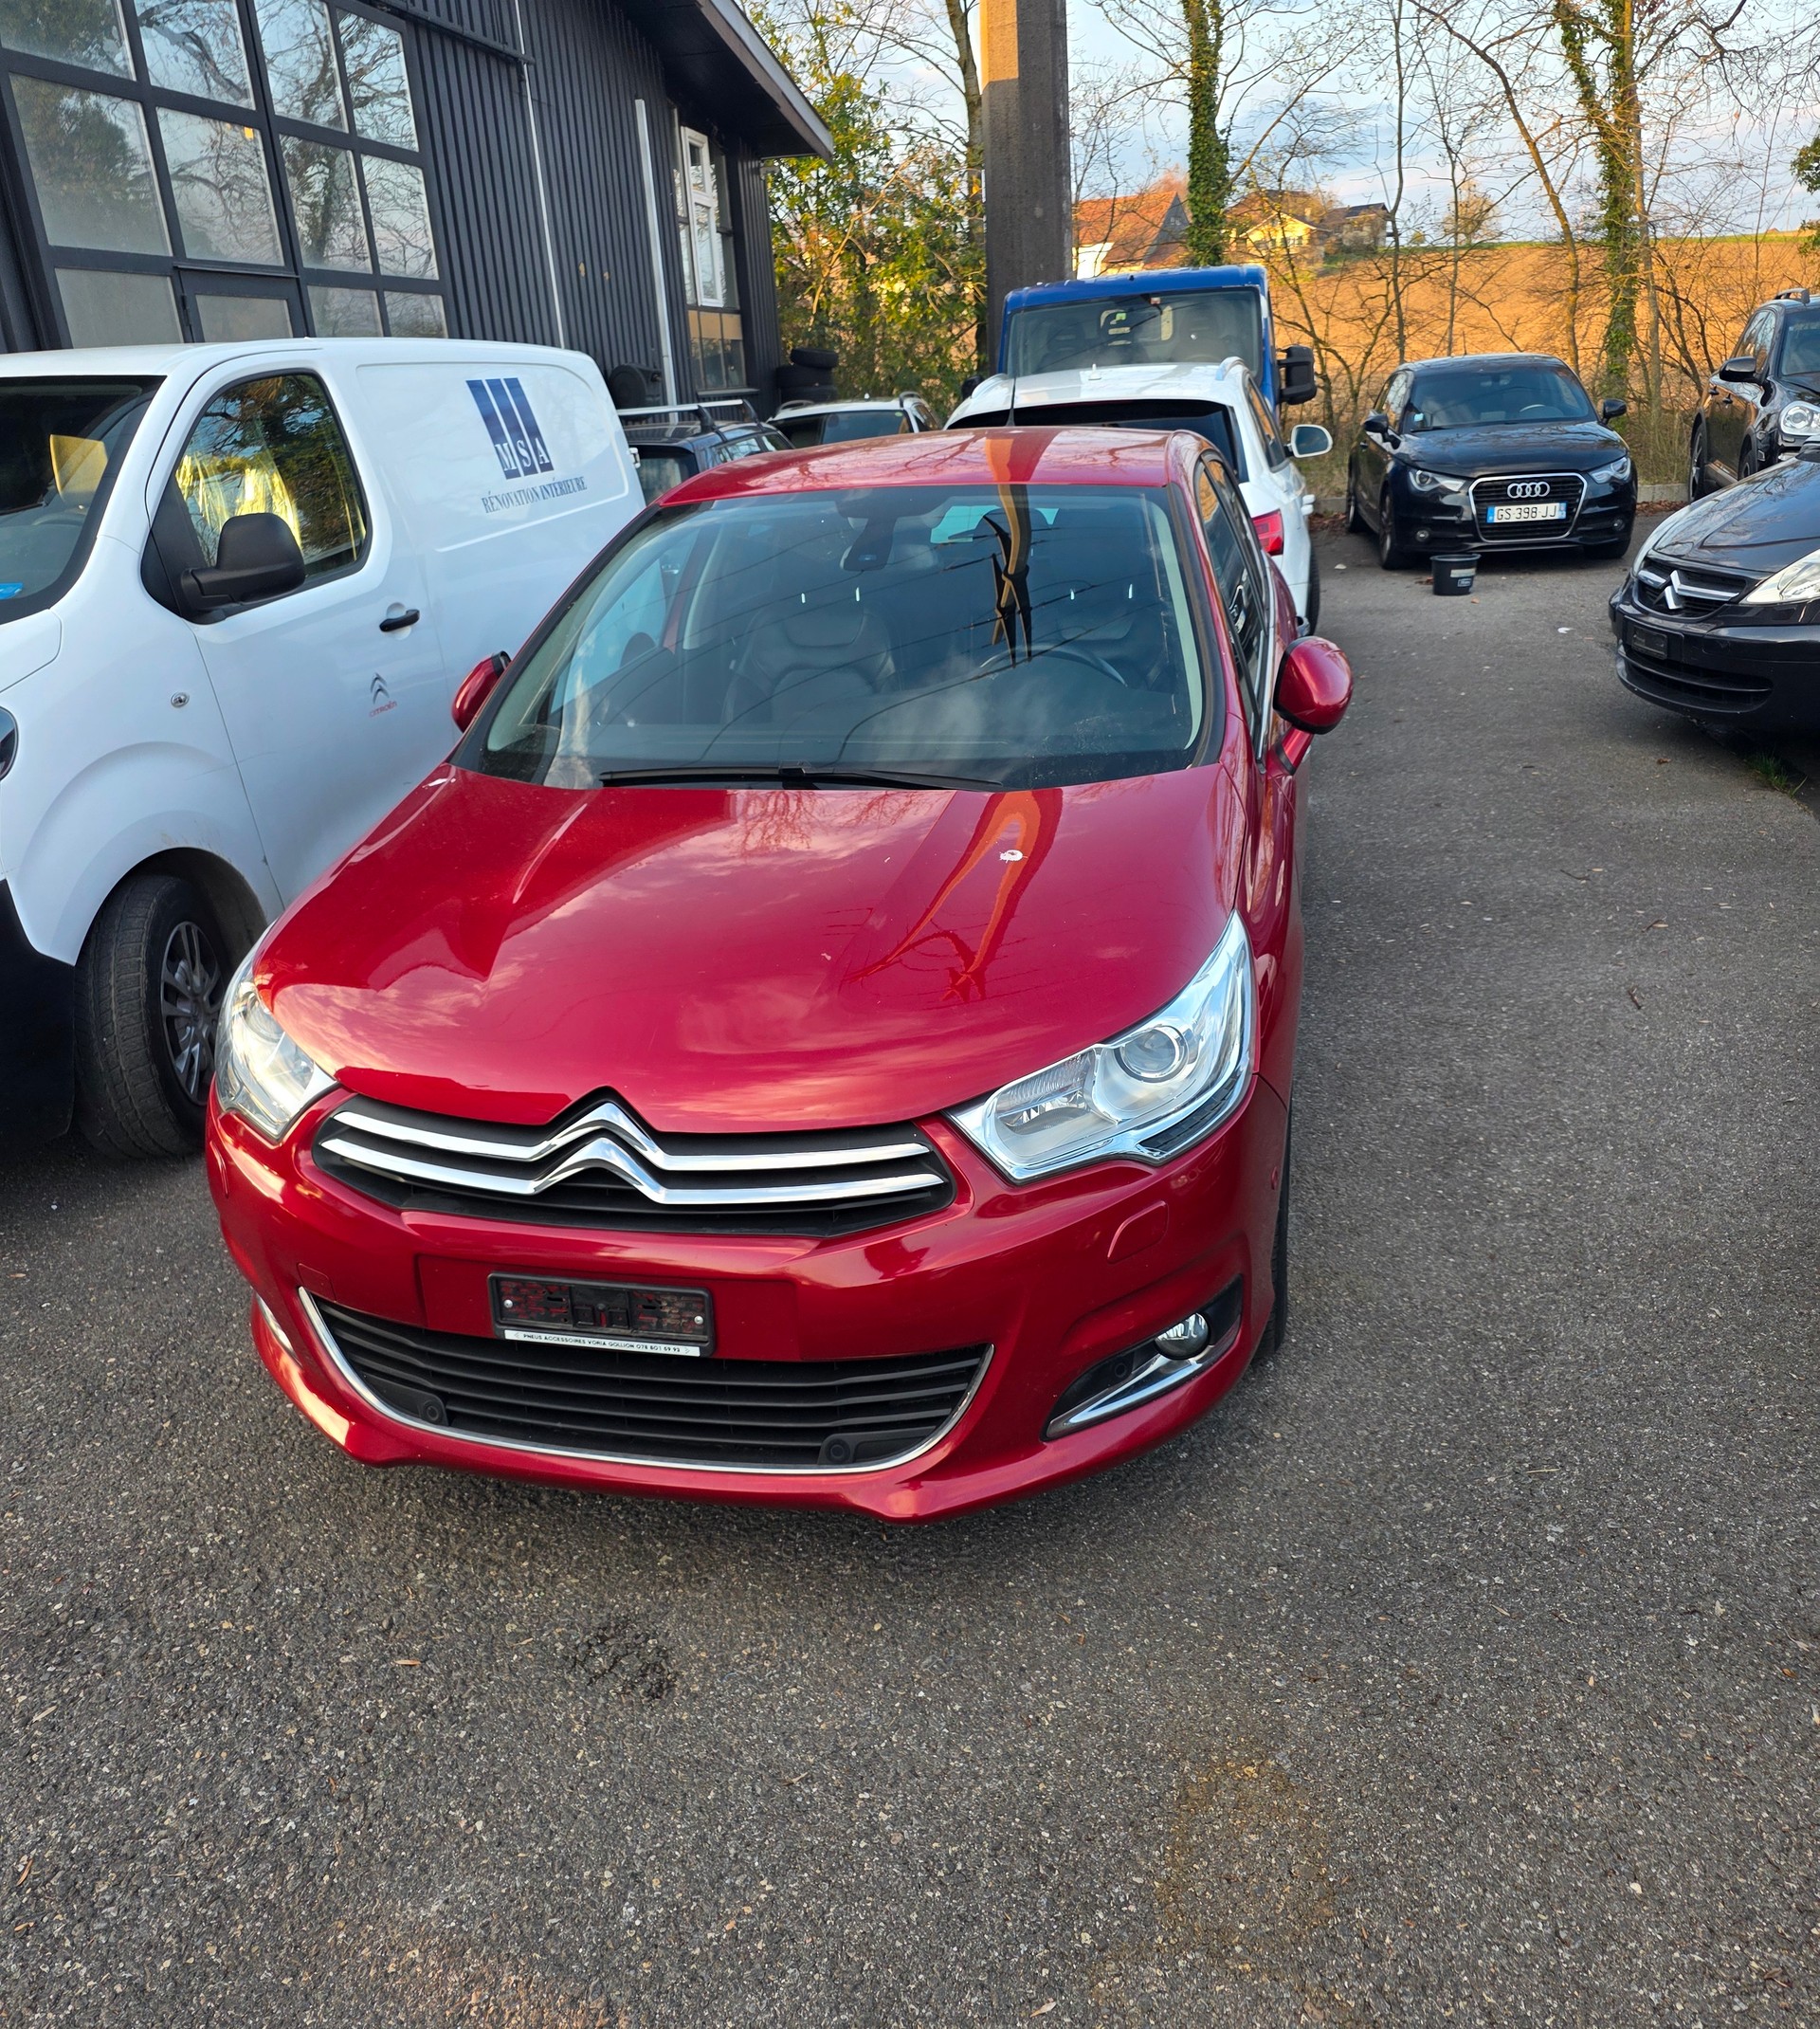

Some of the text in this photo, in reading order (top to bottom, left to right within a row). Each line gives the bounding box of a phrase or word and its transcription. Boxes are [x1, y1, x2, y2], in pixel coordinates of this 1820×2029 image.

[494, 437, 550, 471] MSA
[482, 476, 588, 514] RÉNOVATION INTÉRIEURE
